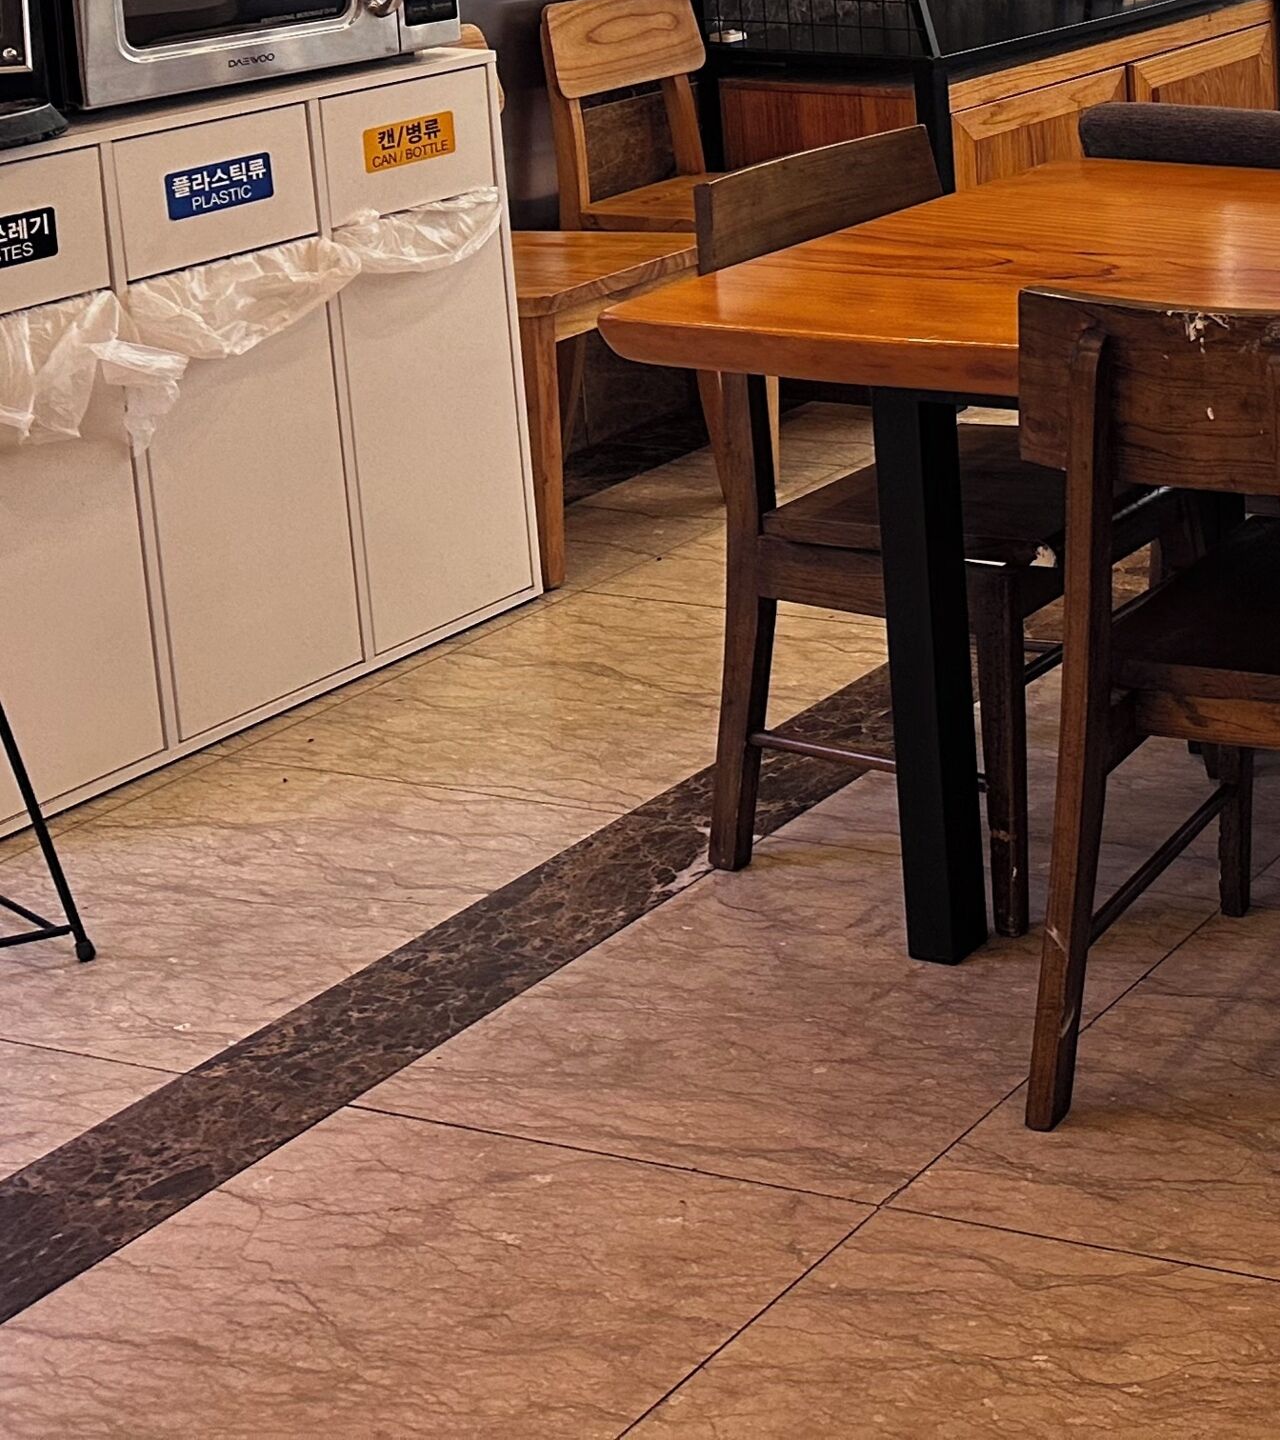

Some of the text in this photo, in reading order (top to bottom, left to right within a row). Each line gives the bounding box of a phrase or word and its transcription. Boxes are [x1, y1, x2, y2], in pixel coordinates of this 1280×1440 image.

[228, 52, 275, 68] DAEWOO
[377, 118, 441, 150] 캔/병류
[371, 152, 397, 170] CAN
[405, 139, 448, 160] BOTTLE
[172, 158, 267, 199] 플라스틱류
[192, 185, 252, 211] PLASTIC
[0, 242, 34, 262] TES
